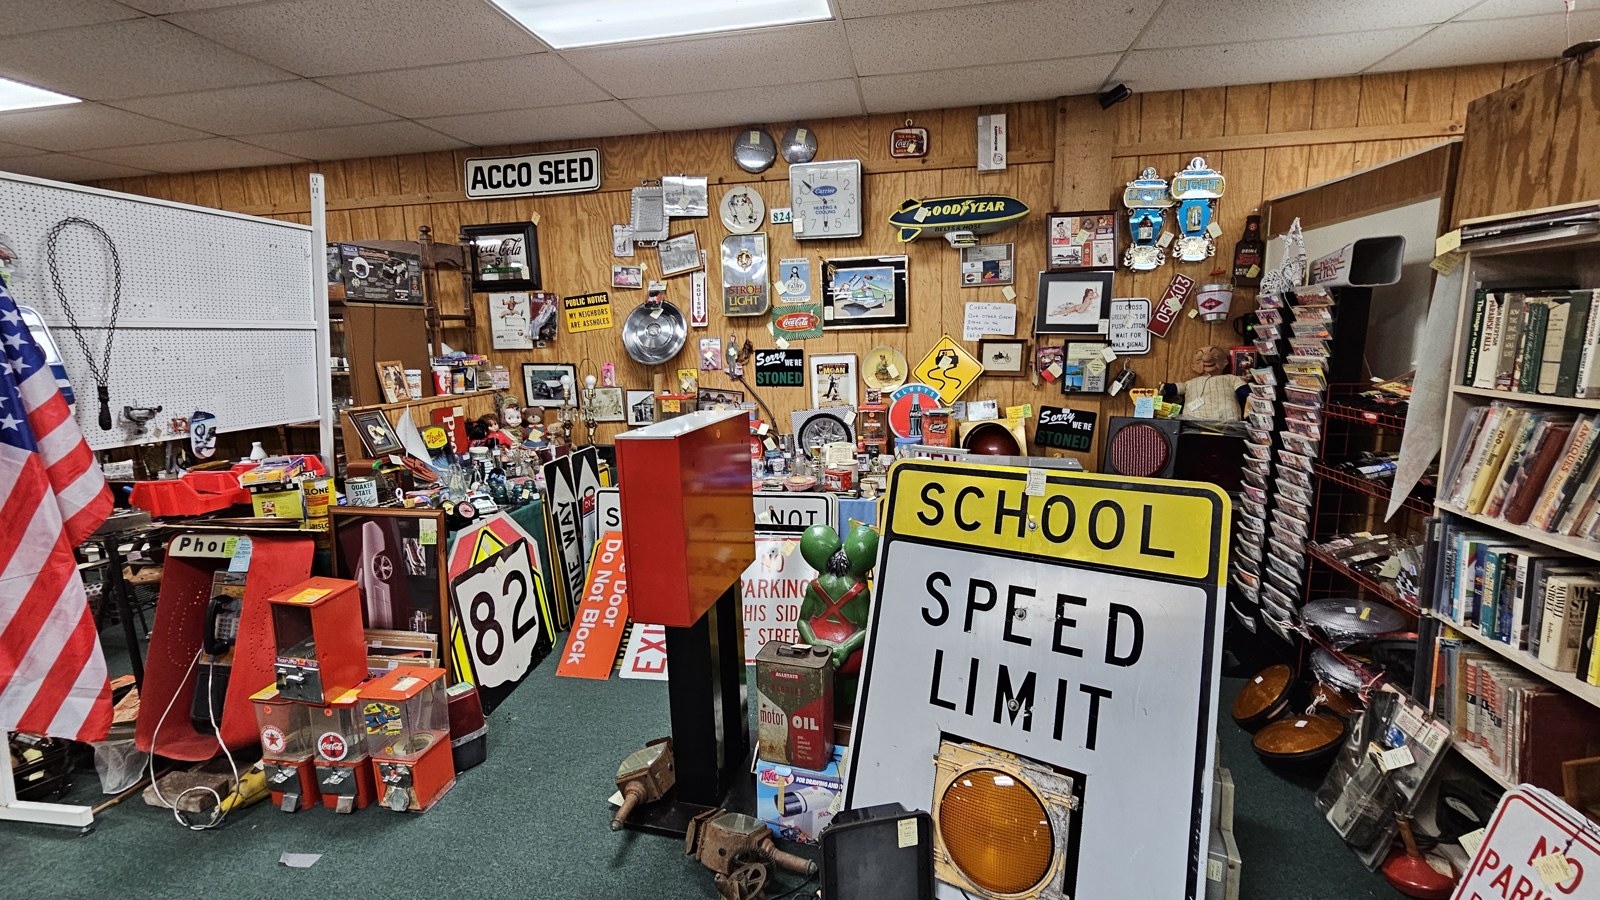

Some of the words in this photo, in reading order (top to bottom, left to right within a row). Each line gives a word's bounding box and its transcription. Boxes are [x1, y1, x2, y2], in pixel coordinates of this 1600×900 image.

[471, 162, 531, 190] ACCO
[538, 157, 594, 185] SEED
[843, 179, 850, 190] 2
[1176, 180, 1219, 191] LIGHT
[795, 197, 803, 207] 9
[848, 193, 856, 204] 3
[1128, 189, 1168, 201] LIGHT
[773, 212, 791, 222] 824
[843, 208, 851, 218] 4
[925, 201, 1005, 217] GOODYEAR
[811, 219, 817, 229] 7
[835, 218, 842, 228] 5
[935, 225, 955, 233] BELTS
[963, 223, 982, 231] HOSE
[565, 298, 586, 308] PUBLIC
[586, 295, 608, 305] NOTICE
[729, 296, 759, 306] LIGHT
[579, 308, 609, 318] NEIGHBORS
[1485, 300, 1495, 331] PARADISE
[570, 321, 581, 329] ARE
[583, 318, 610, 327] ASSHOLES
[783, 317, 808, 327] Coca-Cola
[1474, 313, 1482, 331] Image
[1483, 331, 1492, 352] FALLS
[756, 351, 787, 366] Sorry
[785, 358, 802, 366] WE'RE
[1467, 347, 1477, 378] Greatness
[757, 372, 803, 385] STONED
[1040, 411, 1075, 424] Sorry
[1072, 421, 1093, 430] WE'RE
[1037, 429, 1090, 449] STONED
[1562, 424, 1592, 473] ANTIQUES
[557, 501, 577, 550] WAY
[917, 481, 1176, 559] SCHOOL
[601, 539, 622, 563] Do
[568, 554, 583, 605] ONE
[588, 570, 613, 602] Not
[603, 580, 627, 628] Door
[469, 570, 537, 666] 82
[744, 605, 767, 622] HIS
[775, 605, 798, 622] SID
[921, 571, 1145, 668] SPEED
[567, 609, 600, 665] Block
[632, 624, 667, 673] EXI
[930, 649, 1112, 751] LIMIT
[760, 708, 785, 727] motor
[792, 715, 820, 731] OIL
[796, 776, 806, 784] FOR
[806, 778, 828, 787] DRAWING
[828, 781, 839, 789] AND
